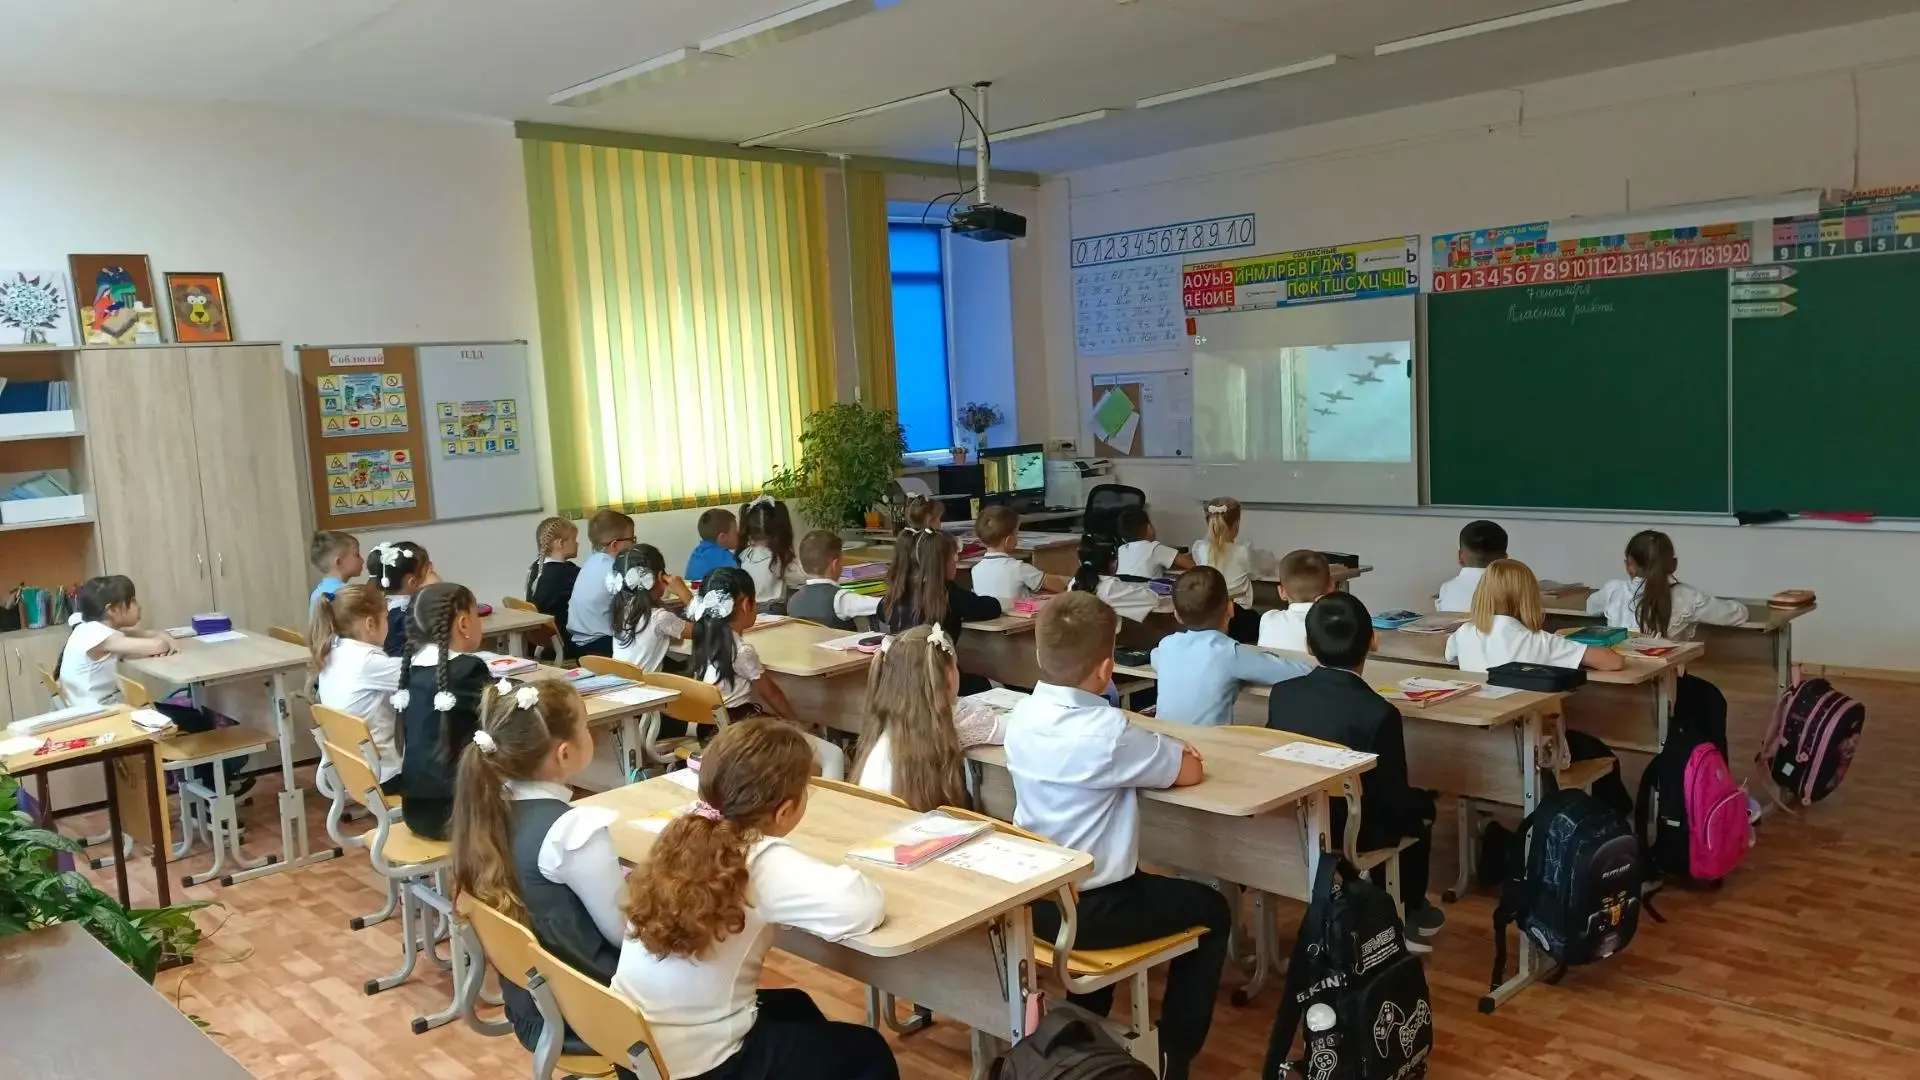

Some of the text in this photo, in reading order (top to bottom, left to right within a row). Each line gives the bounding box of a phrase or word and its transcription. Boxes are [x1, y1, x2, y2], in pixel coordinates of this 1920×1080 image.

[1076, 217, 1252, 264] 0 1 2 3 4 5 6 7 8 9 10
[1293, 247, 1338, 259] СОГЛАСНЫЕ
[1780, 235, 1914, 260] 9 8 7 6 5 4
[1405, 248, 1417, 263] Ь
[1434, 242, 1750, 292] 0 1 2 3 4 5 6 7 8 9 10 11 12 13 14 15 16 17 18 19 20
[1194, 335, 1208, 346] 6+
[330, 353, 384, 365] Соблюдай
[460, 350, 485, 360] ПДД
